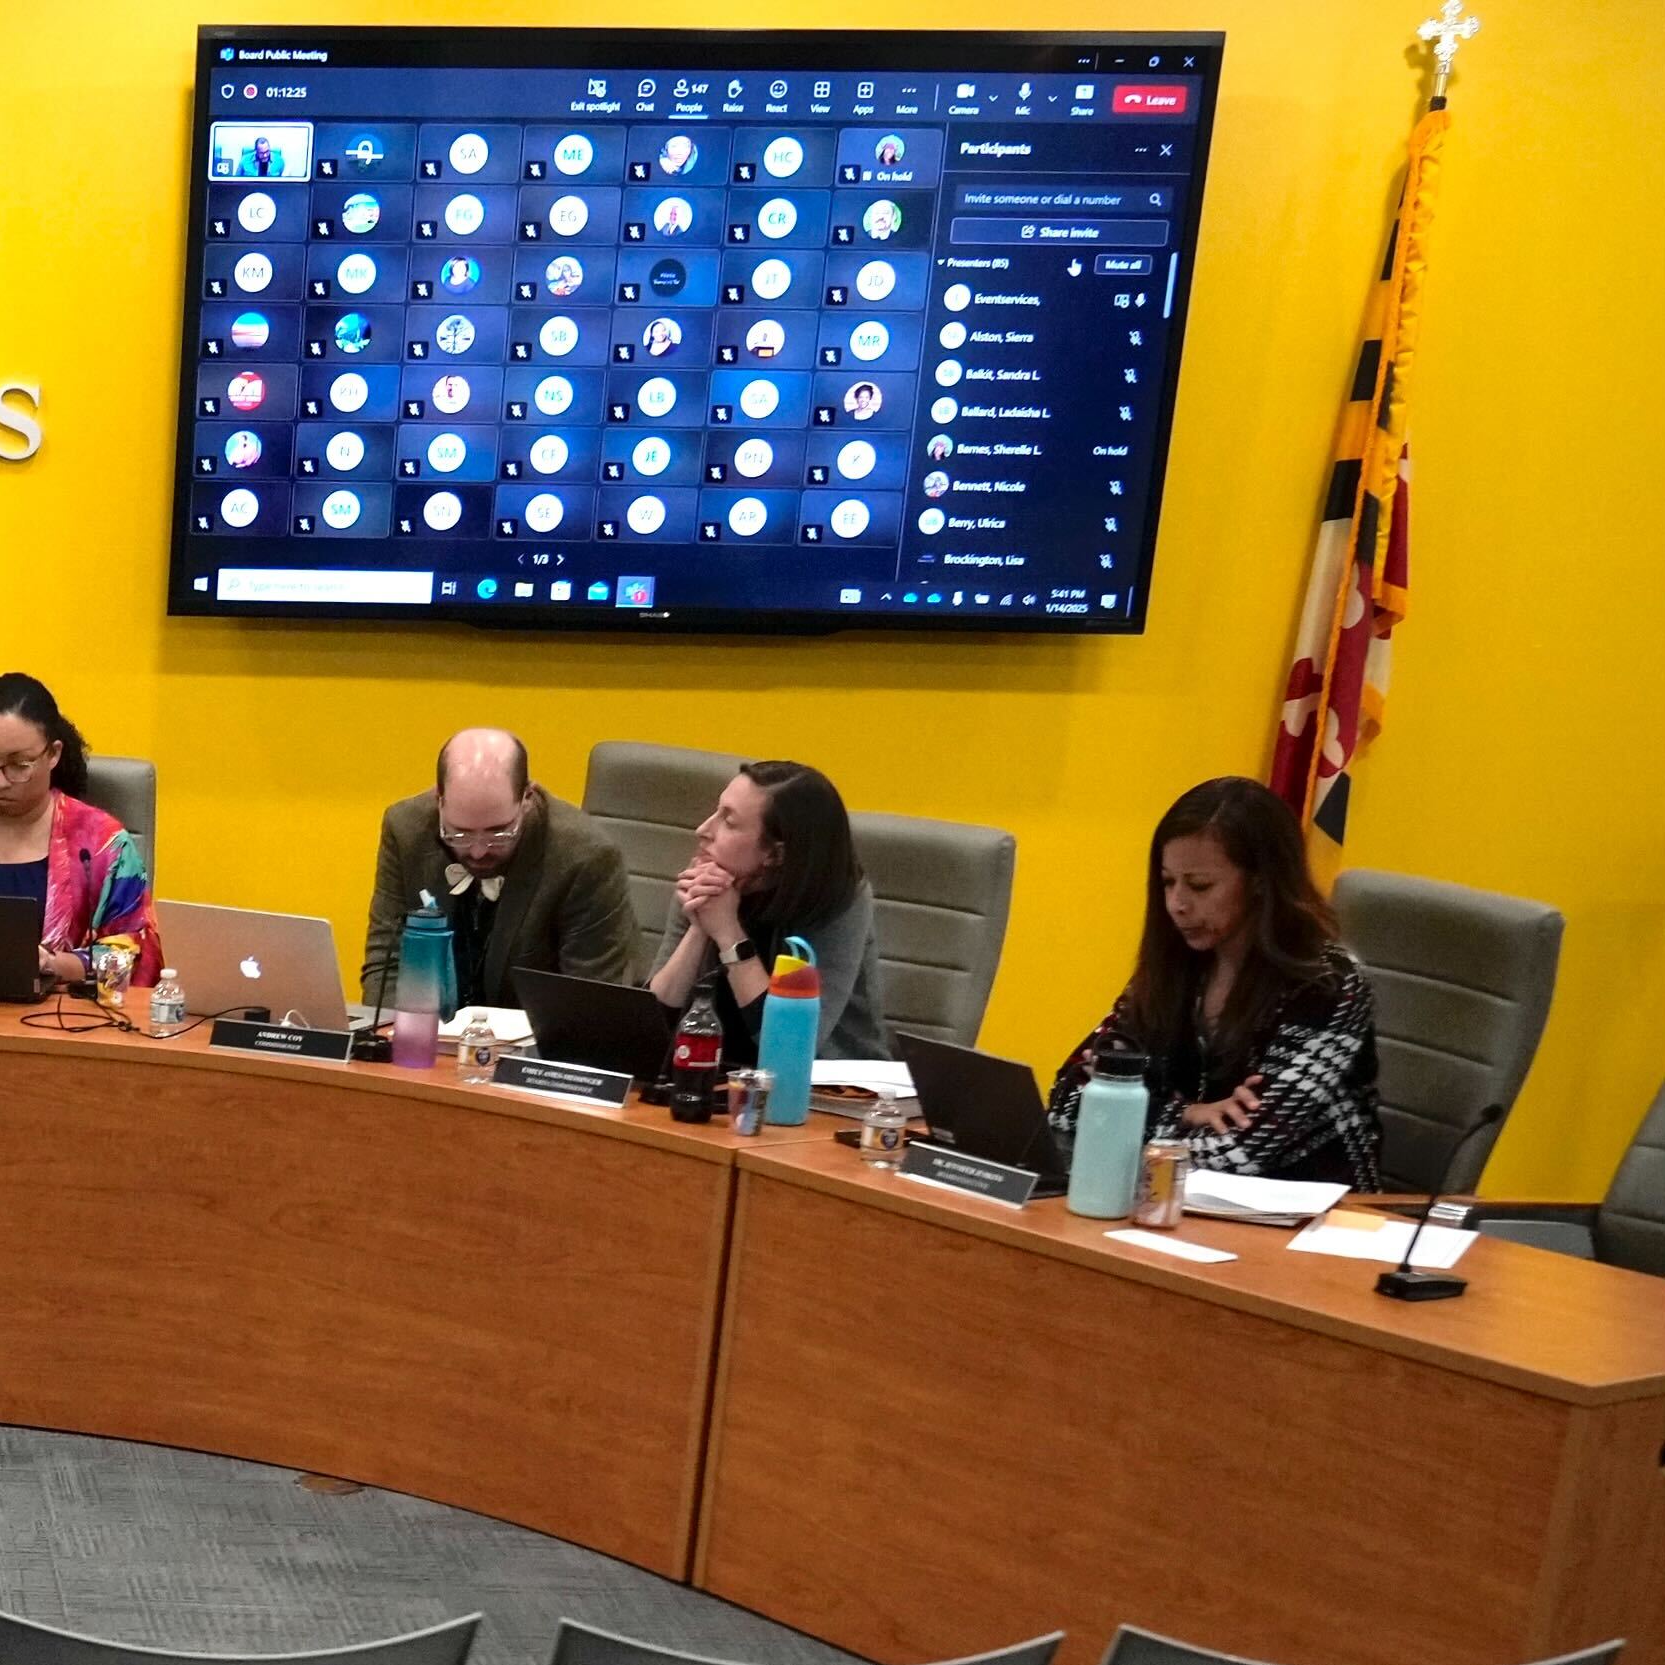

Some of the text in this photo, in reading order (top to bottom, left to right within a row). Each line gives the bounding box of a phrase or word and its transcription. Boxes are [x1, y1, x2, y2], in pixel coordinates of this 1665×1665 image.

[239, 50, 327, 62] Board Public Meeting
[266, 87, 306, 97] 01:12:25
[692, 84, 708, 94] 147
[1146, 96, 1176, 106] Leave
[571, 102, 620, 112] Exit spotlight
[636, 103, 654, 112] Chat
[676, 103, 702, 113] People
[723, 104, 743, 112] Raise
[766, 104, 787, 113] React
[811, 104, 830, 113] View
[854, 105, 873, 115] Apps
[896, 105, 917, 114] More
[949, 106, 979, 114] Camera
[1016, 107, 1030, 115] Mic
[1071, 107, 1094, 116] Share
[960, 143, 1031, 158] Participants
[877, 172, 912, 181] On hold
[965, 194, 990, 204] Invite
[992, 195, 1038, 204] someone
[1041, 196, 1052, 204] or
[1054, 194, 1071, 204] dial
[1082, 195, 1121, 205] number
[1040, 227, 1098, 238] Share invite
[947, 259, 990, 268] Presenters
[1106, 260, 1141, 270] Mute all
[975, 293, 1041, 306] Eventservices,
[970, 332, 1034, 343] Alston, Sierra
[997, 370, 1029, 380] Sandra
[957, 445, 991, 455] Barnes,
[1093, 446, 1127, 456] On hold
[953, 481, 1025, 492] Bennett, Nicole
[948, 518, 976, 530] Berry,
[533, 554, 549, 565] 1/3
[944, 555, 1024, 567] Brockington, Lisa
[1051, 590, 1085, 599] 5:41 PM
[1045, 603, 1088, 614] 1/14/2025
[256, 1032, 287, 1040] ANDREW
